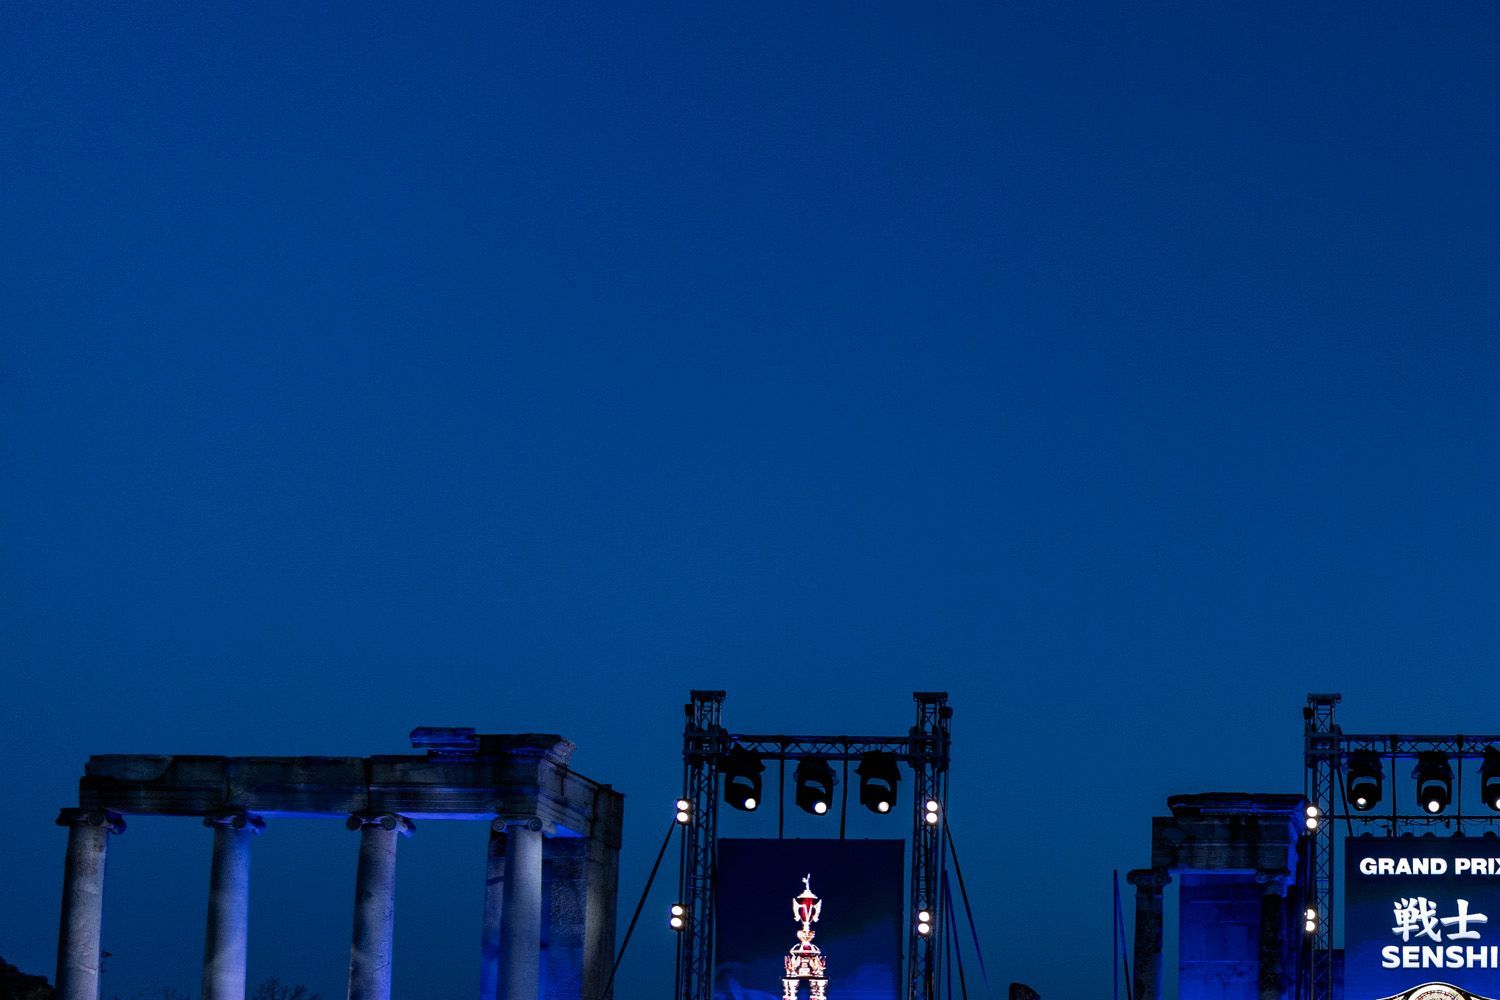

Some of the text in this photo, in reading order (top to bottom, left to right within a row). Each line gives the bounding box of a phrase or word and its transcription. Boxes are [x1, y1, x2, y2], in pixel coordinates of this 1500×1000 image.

[1359, 857, 1447, 875] GRAND
[1391, 896, 1488, 942] 戦士
[1381, 945, 1498, 969] SENSHI
